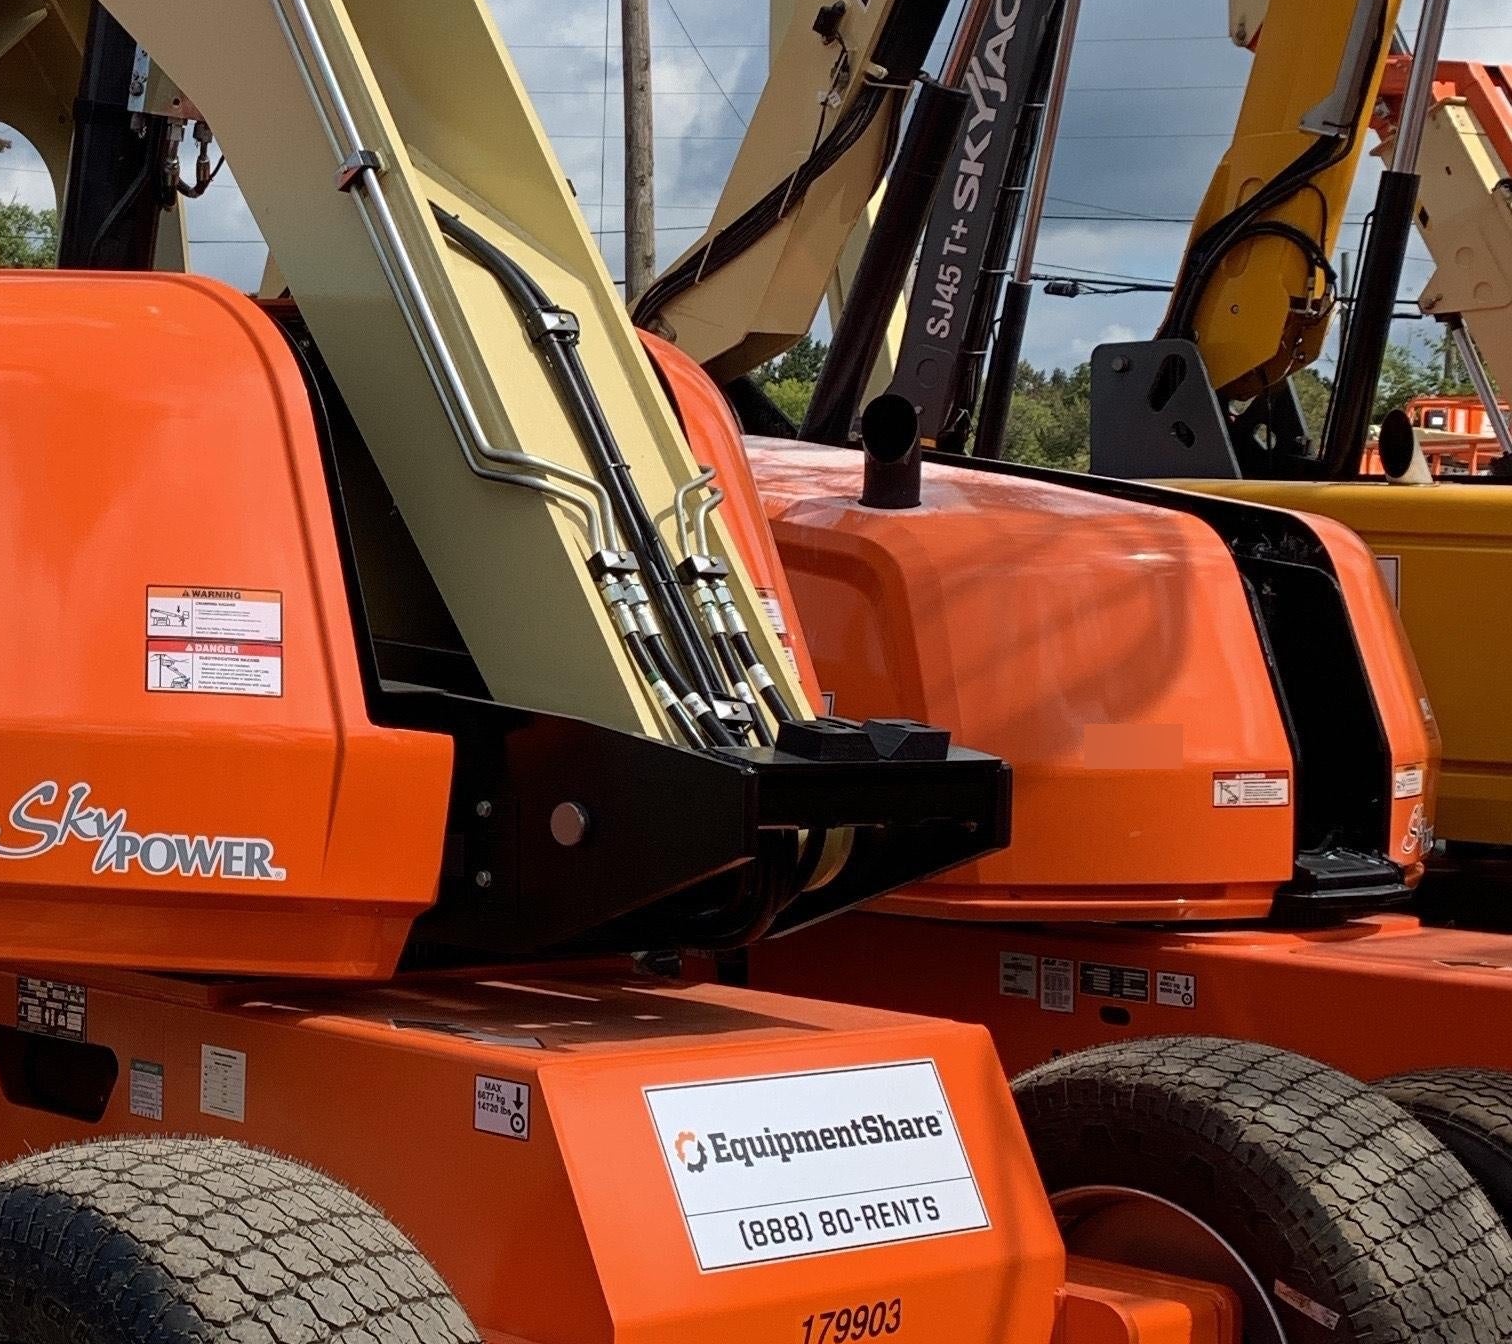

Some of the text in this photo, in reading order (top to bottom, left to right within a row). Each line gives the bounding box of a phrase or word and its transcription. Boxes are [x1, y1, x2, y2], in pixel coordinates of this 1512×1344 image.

[192, 589, 242, 600] WARNING
[194, 643, 239, 654] DANGER
[484, 1081, 502, 1094] MAX
[708, 1112, 943, 1166] EquipmentShare
[739, 1195, 941, 1251] (888) 80-RENTS
